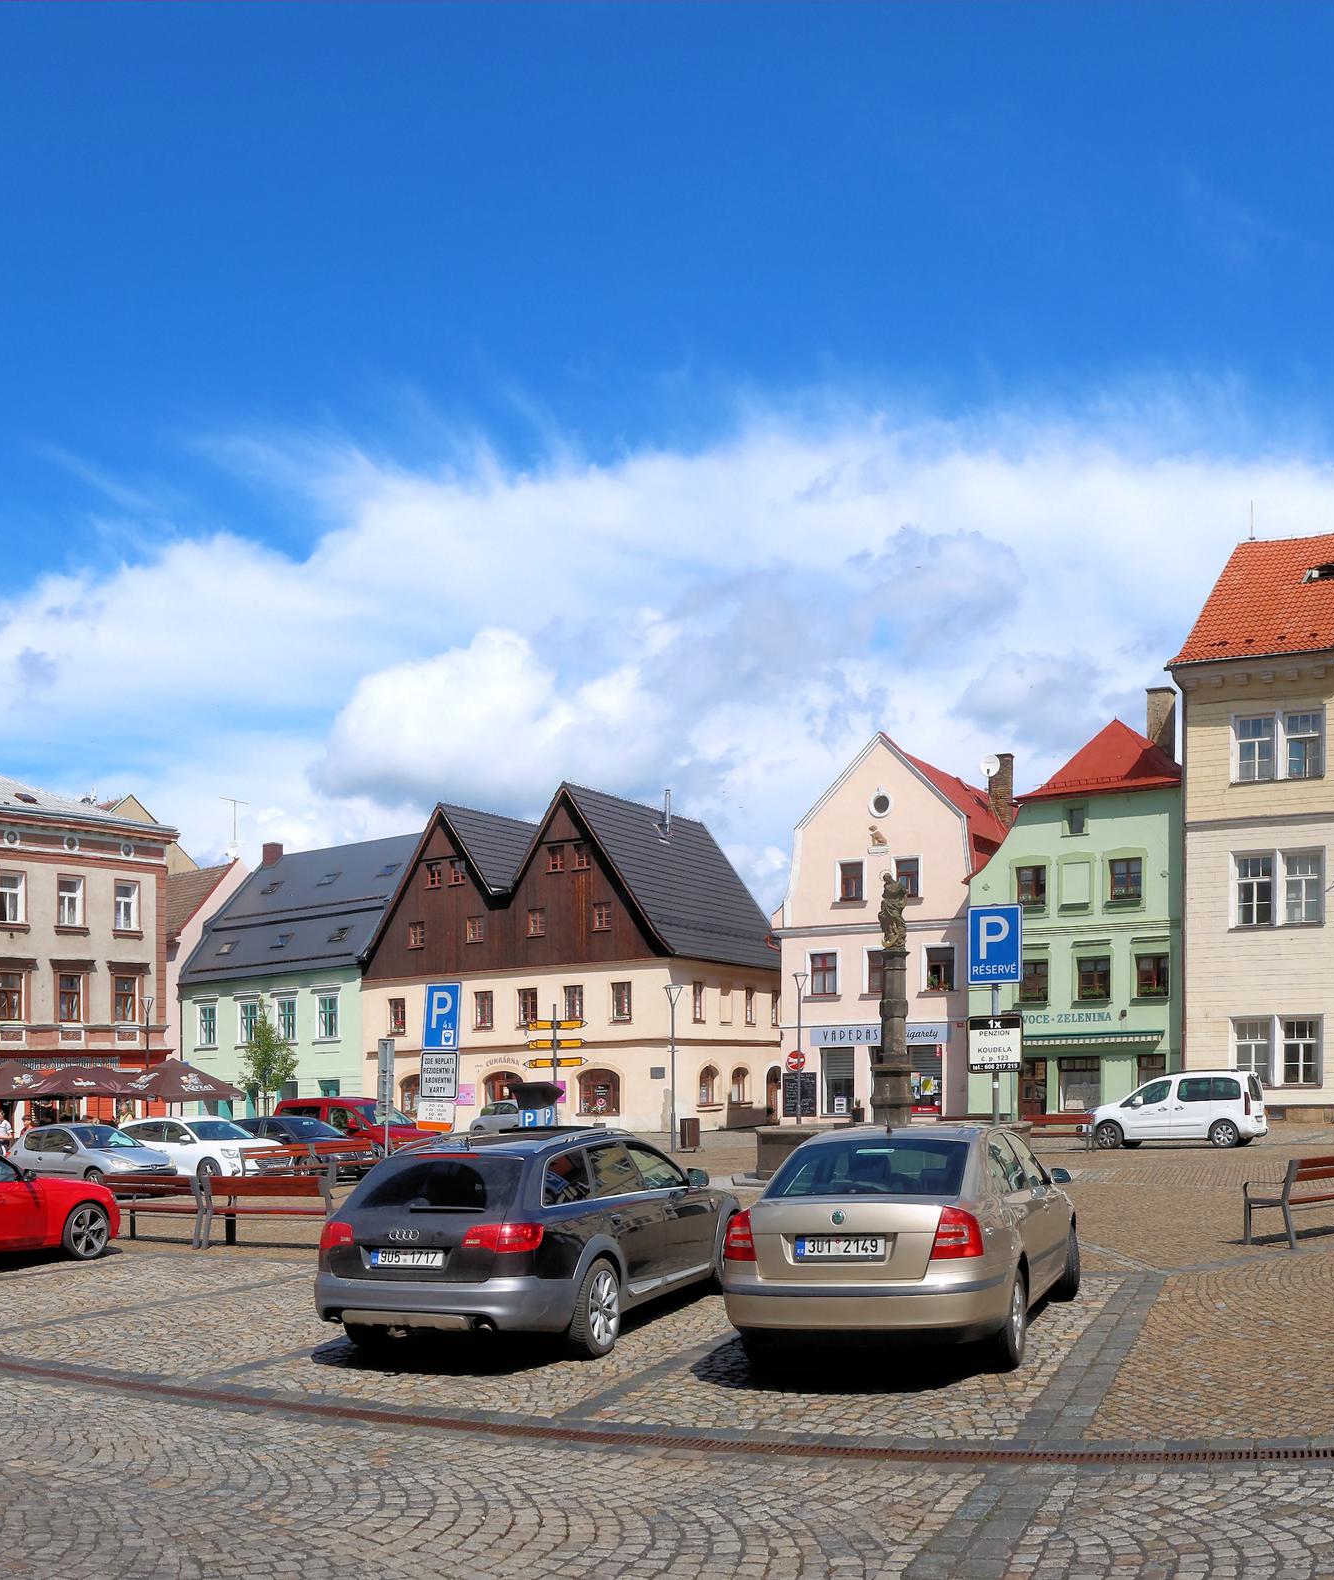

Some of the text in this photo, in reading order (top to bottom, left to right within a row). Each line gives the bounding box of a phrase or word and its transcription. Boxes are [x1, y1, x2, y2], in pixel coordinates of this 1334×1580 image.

[979, 916, 1009, 960] P
[972, 962, 1017, 975] RÉSERVÉ
[431, 991, 452, 1029] P
[443, 1020, 452, 1029] 4x
[988, 1020, 1002, 1029] 1x
[1022, 1012, 1112, 1025] VOCE ZELENINA
[823, 1028, 878, 1042] VAPERAS
[977, 1046, 1012, 1054] KOUDELA
[424, 1057, 434, 1065] ZDE
[485, 1056, 520, 1067] CUKRÁRNA
[995, 1062, 1006, 1070] 217
[525, 1109, 551, 1127] P P
[808, 1239, 831, 1253] 3U1
[843, 1239, 878, 1253] 2149
[380, 1250, 400, 1263] 9U5
[410, 1251, 437, 1264] 1717
